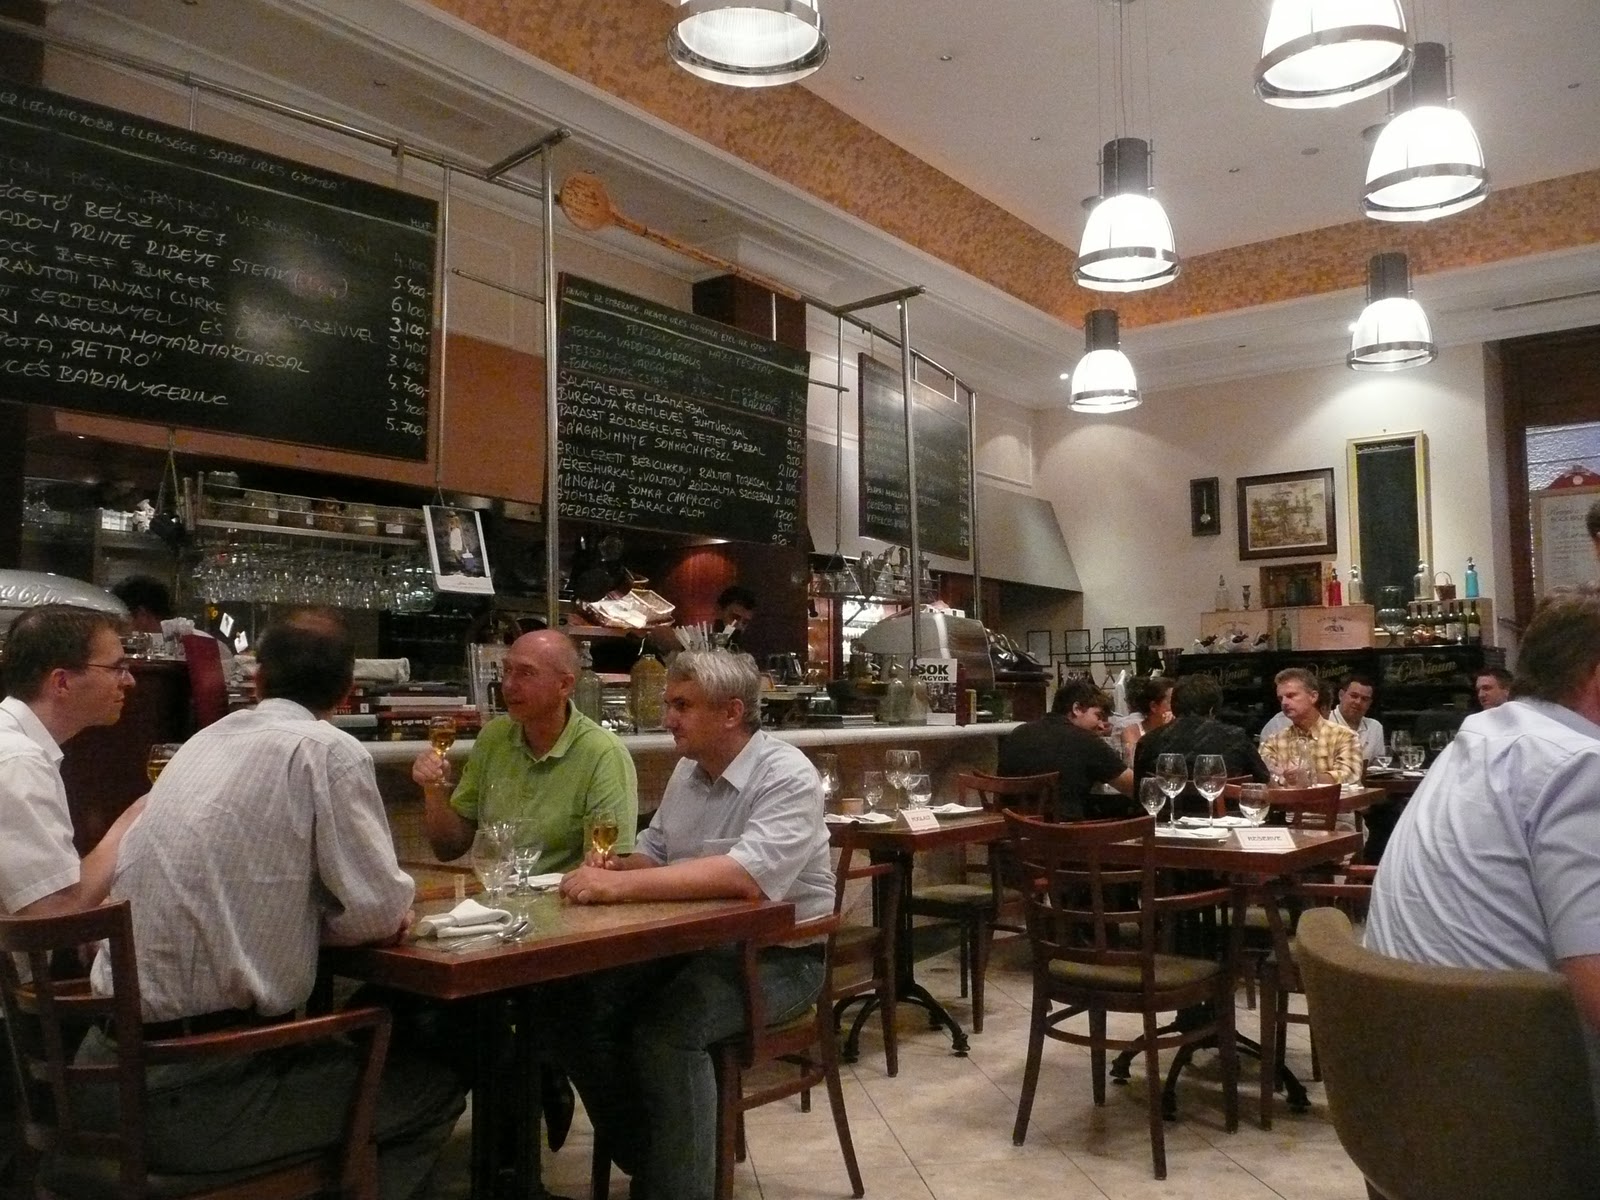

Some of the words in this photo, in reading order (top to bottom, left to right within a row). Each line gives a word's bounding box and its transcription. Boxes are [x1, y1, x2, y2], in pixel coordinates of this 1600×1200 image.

[70, 222, 136, 250] PRIME
[145, 240, 222, 268] RIBEYE
[54, 245, 118, 270] BEEF
[131, 259, 215, 291] BURGER
[169, 290, 228, 316] CSIRKE
[35, 313, 126, 339] ANGOLNA
[56, 364, 229, 405] BÁRÁNYGERINC
[627, 484, 663, 499] SONKA
[557, 502, 639, 524] PERASZELET
[916, 664, 949, 676] SOK
